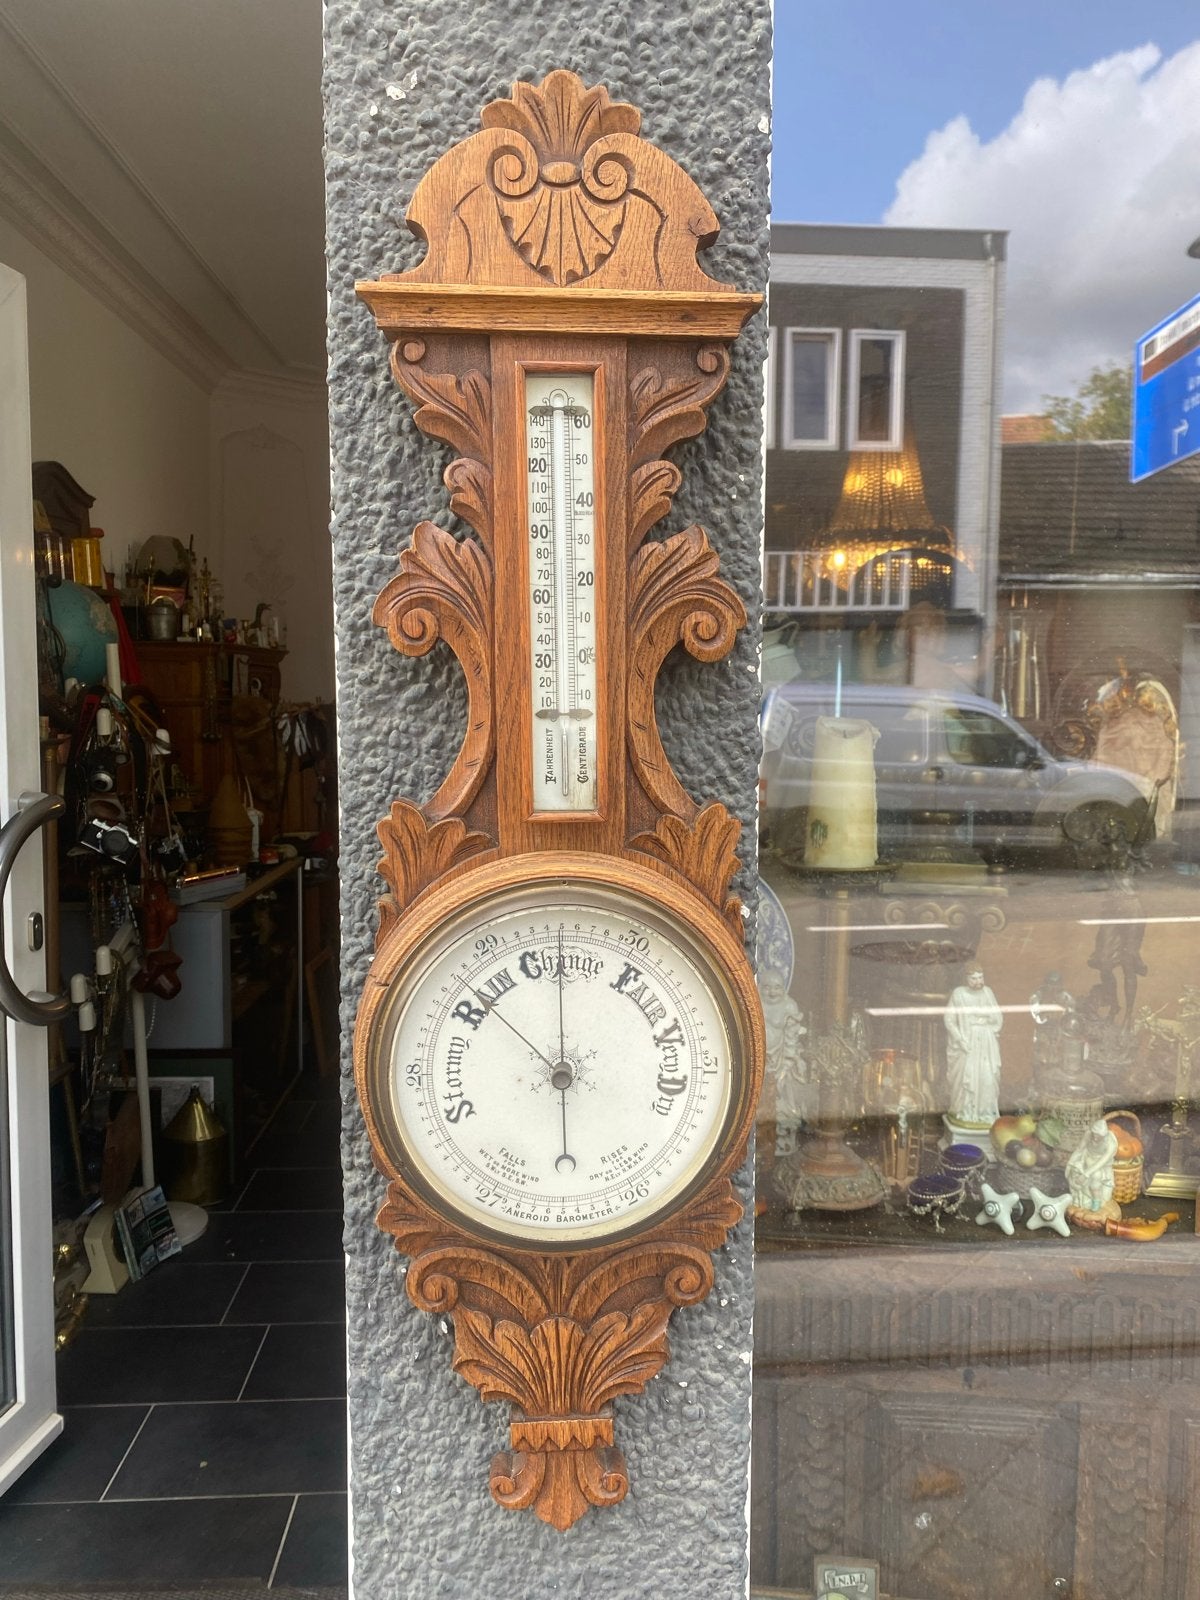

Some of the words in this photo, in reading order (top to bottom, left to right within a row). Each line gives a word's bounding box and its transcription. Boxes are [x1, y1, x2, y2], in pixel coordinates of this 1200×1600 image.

[530, 415, 545, 426] 140
[574, 414, 591, 429] 60
[531, 438, 546, 448] 130
[528, 458, 547, 473] 120
[576, 454, 588, 465] 50
[531, 482, 547, 494] 110
[532, 502, 548, 513] 100
[576, 492, 593, 508] 40
[531, 524, 548, 539] 90
[577, 534, 590, 545] 30
[536, 548, 549, 559] 80
[537, 570, 549, 580] 70
[577, 571, 594, 586] 20
[533, 589, 550, 605] 60
[537, 612, 550, 623] 50
[580, 612, 591, 623] 10
[537, 634, 551, 645] 40
[535, 654, 551, 668] 30
[579, 649, 587, 664] 0
[539, 677, 552, 688] 20
[541, 697, 552, 707] 10
[580, 689, 591, 700] 10
[545, 728, 556, 784] FAHRENHEIT
[577, 726, 589, 784] CENTIGRADE
[475, 934, 498, 954] 29
[624, 929, 649, 952] 30
[519, 949, 603, 980] Change
[451, 967, 518, 1031] RAIN
[609, 961, 667, 1028] FAIR
[703, 1056, 718, 1075] 31
[406, 1063, 421, 1086] 28
[443, 1036, 477, 1124] Stormy
[499, 1147, 526, 1167] FALLS
[600, 1145, 627, 1164] RISES
[590, 1171, 603, 1180] DRY
[475, 1187, 503, 1207] 27
[625, 1184, 649, 1206] 26
[505, 1207, 549, 1222] ANEROID
[556, 1207, 614, 1223] BAROMETER
